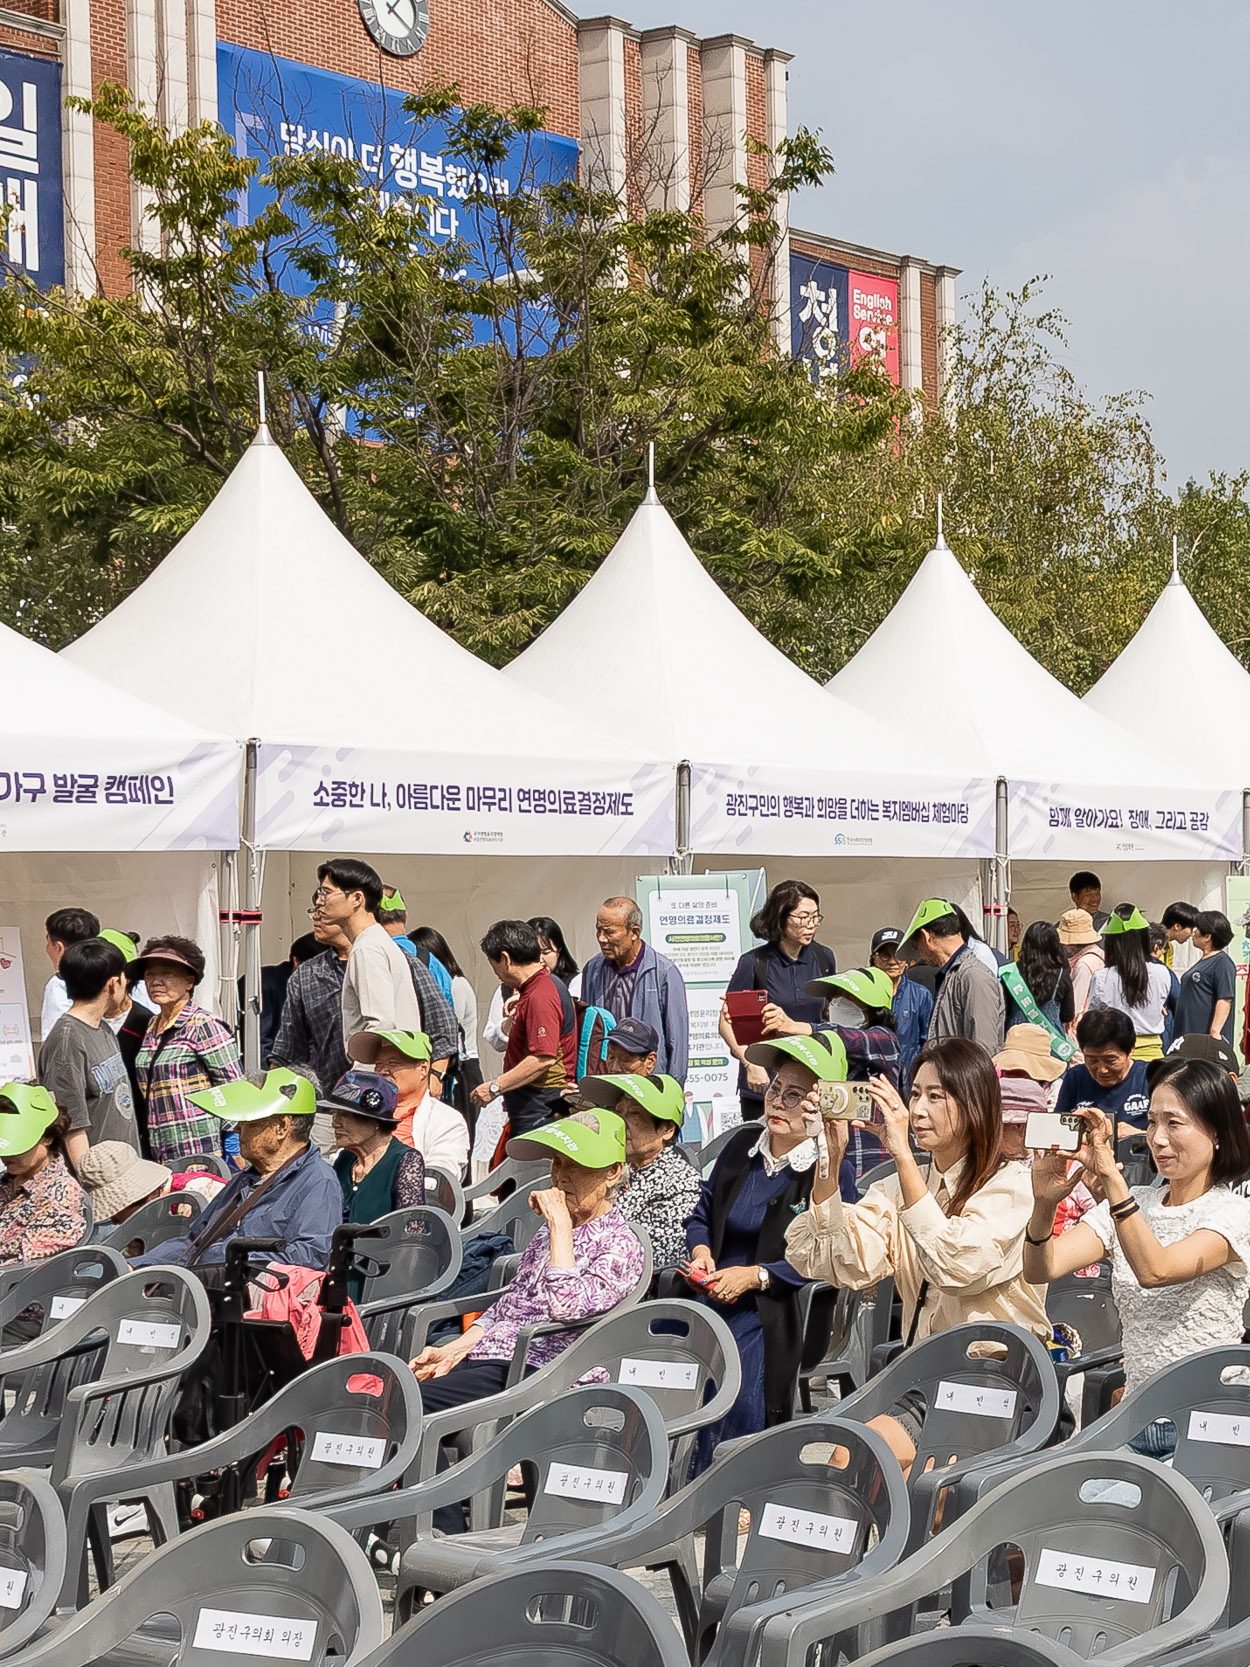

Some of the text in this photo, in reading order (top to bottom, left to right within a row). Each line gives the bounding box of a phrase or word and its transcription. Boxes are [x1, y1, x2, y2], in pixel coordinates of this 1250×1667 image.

[853, 287, 892, 311] English
[53, 773, 99, 804] 발굴
[104, 775, 175, 805] 캠페인
[313, 780, 635, 816] 소중한 나, 아름다운 마무리 연명의료결정제도
[726, 793, 780, 818] 광진구민의
[783, 795, 814, 819] 행복과
[816, 796, 847, 820] 희망을
[850, 798, 879, 820] 더하는
[1155, 810, 1187, 830] 그리고
[1189, 811, 1209, 831] 공감
[659, 914, 731, 926] 연명의료결정제도
[213, 1622, 304, 1648] 광진구의회 의장
